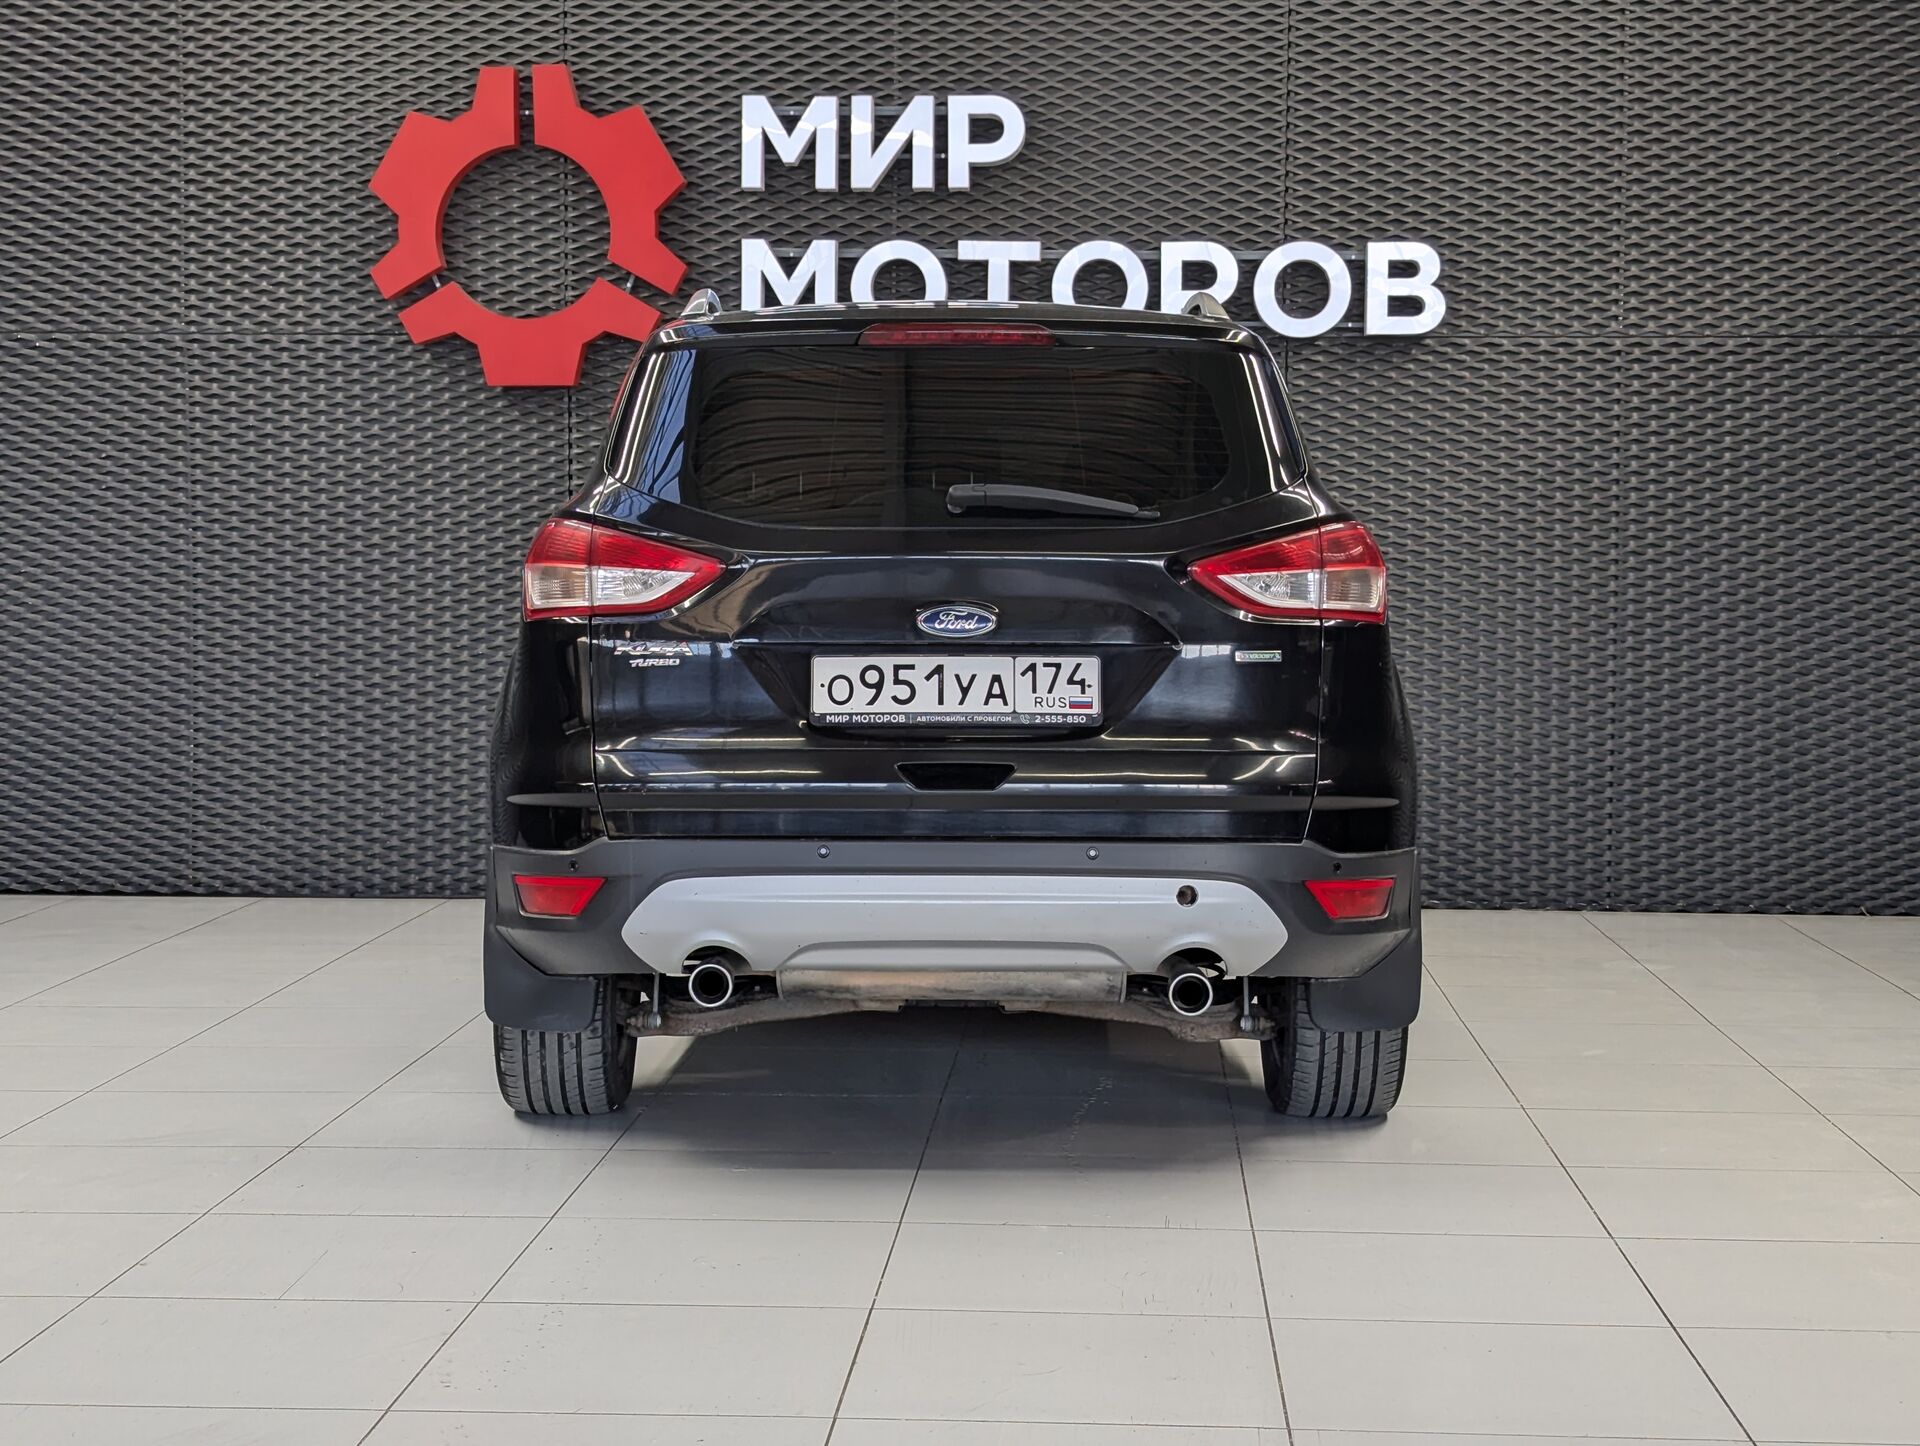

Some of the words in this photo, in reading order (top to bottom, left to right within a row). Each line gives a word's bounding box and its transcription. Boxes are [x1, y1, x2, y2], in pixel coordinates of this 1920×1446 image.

[740, 94, 1026, 193] МИР
[740, 238, 1448, 338] МОТОРОВ
[934, 610, 979, 630] Ford
[629, 658, 680, 668] TURBO
[1019, 662, 1087, 695] 174
[1033, 696, 1067, 709] RUS
[826, 714, 850, 723] МИР
[852, 714, 906, 723] МОТОРОВ
[1034, 714, 1087, 723] 2-555-850
